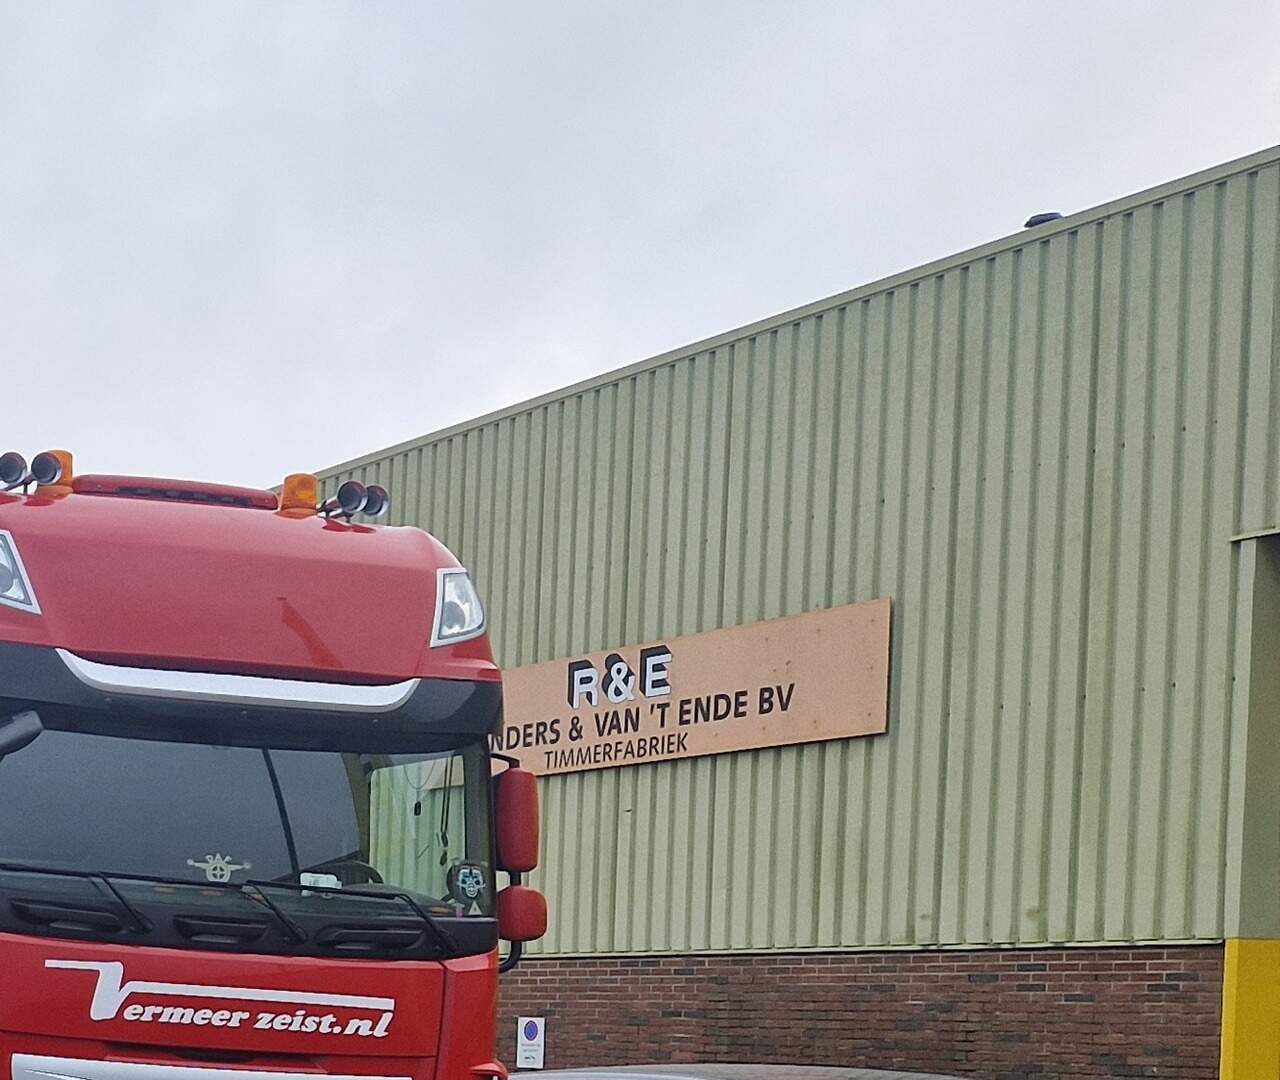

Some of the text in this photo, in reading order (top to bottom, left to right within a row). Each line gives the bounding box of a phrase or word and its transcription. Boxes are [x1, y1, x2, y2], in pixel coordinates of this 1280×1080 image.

[568, 645, 672, 709] R&E
[569, 716, 583, 742] &
[595, 706, 640, 737] VAN
[650, 702, 670, 729] 'T
[679, 690, 748, 726] ENDE
[759, 683, 795, 715] BV
[544, 732, 689, 770] TIMMERFABRIEK
[253, 1010, 394, 1038] zeist.nl
